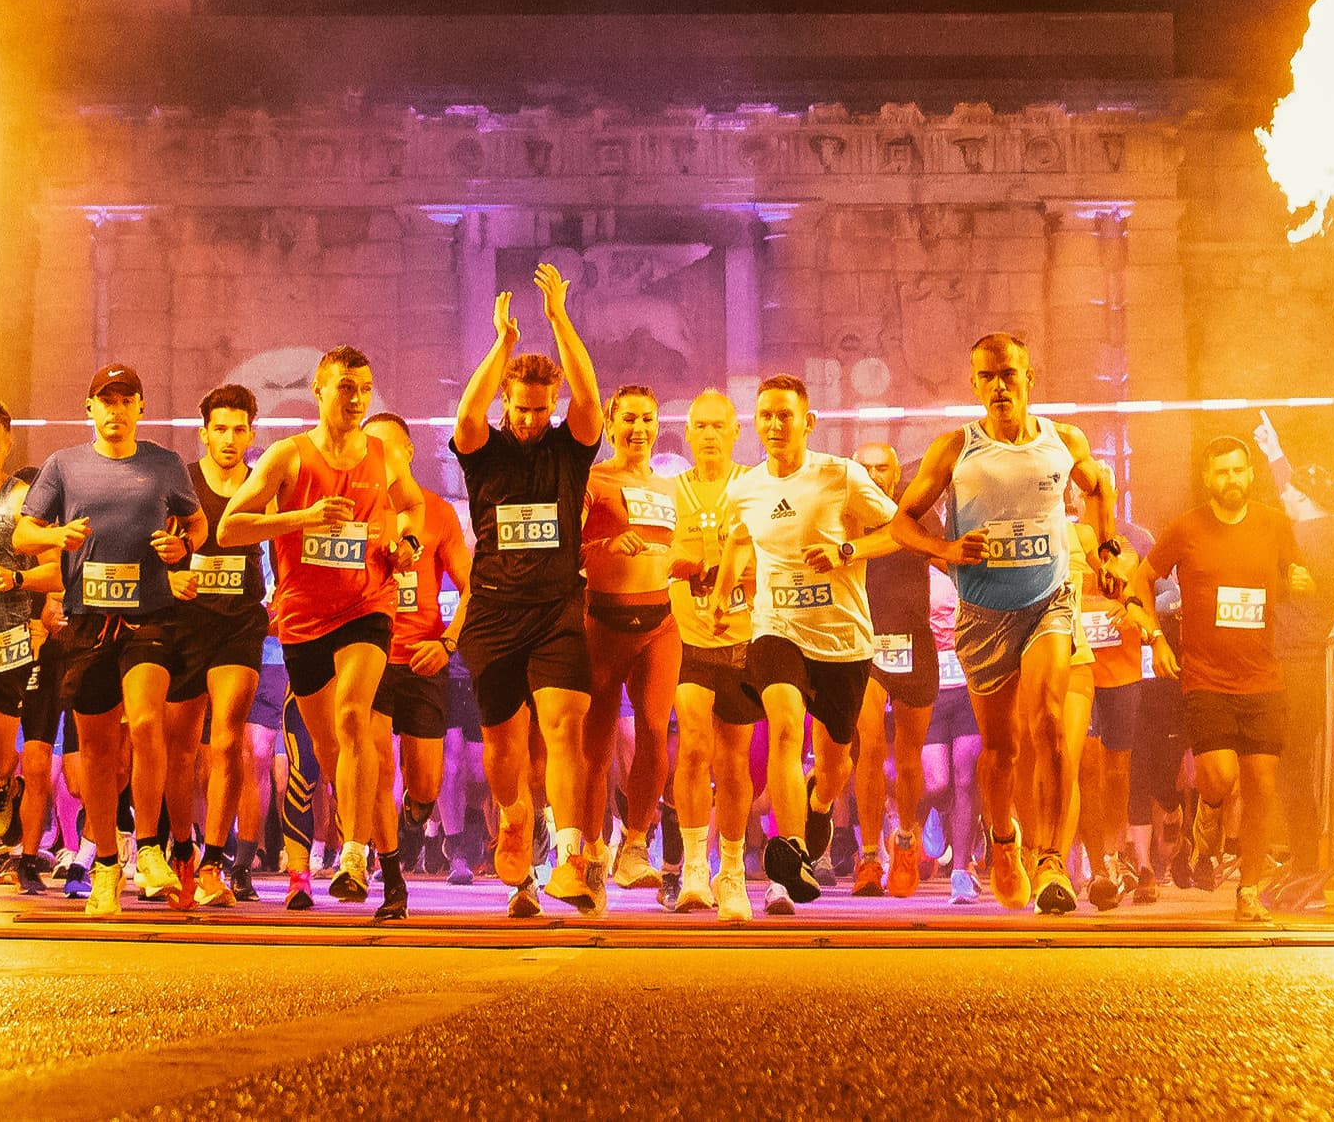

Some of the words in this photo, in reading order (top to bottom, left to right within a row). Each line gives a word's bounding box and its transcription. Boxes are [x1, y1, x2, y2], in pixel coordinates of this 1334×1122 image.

[630, 501, 676, 520] 0212
[771, 510, 796, 519] adidas
[500, 522, 556, 541] 0189
[304, 538, 361, 560] 0101
[989, 537, 1048, 558] 0130
[85, 580, 137, 599] 0107
[774, 587, 829, 607] 0235
[1219, 604, 1263, 621] 0041
